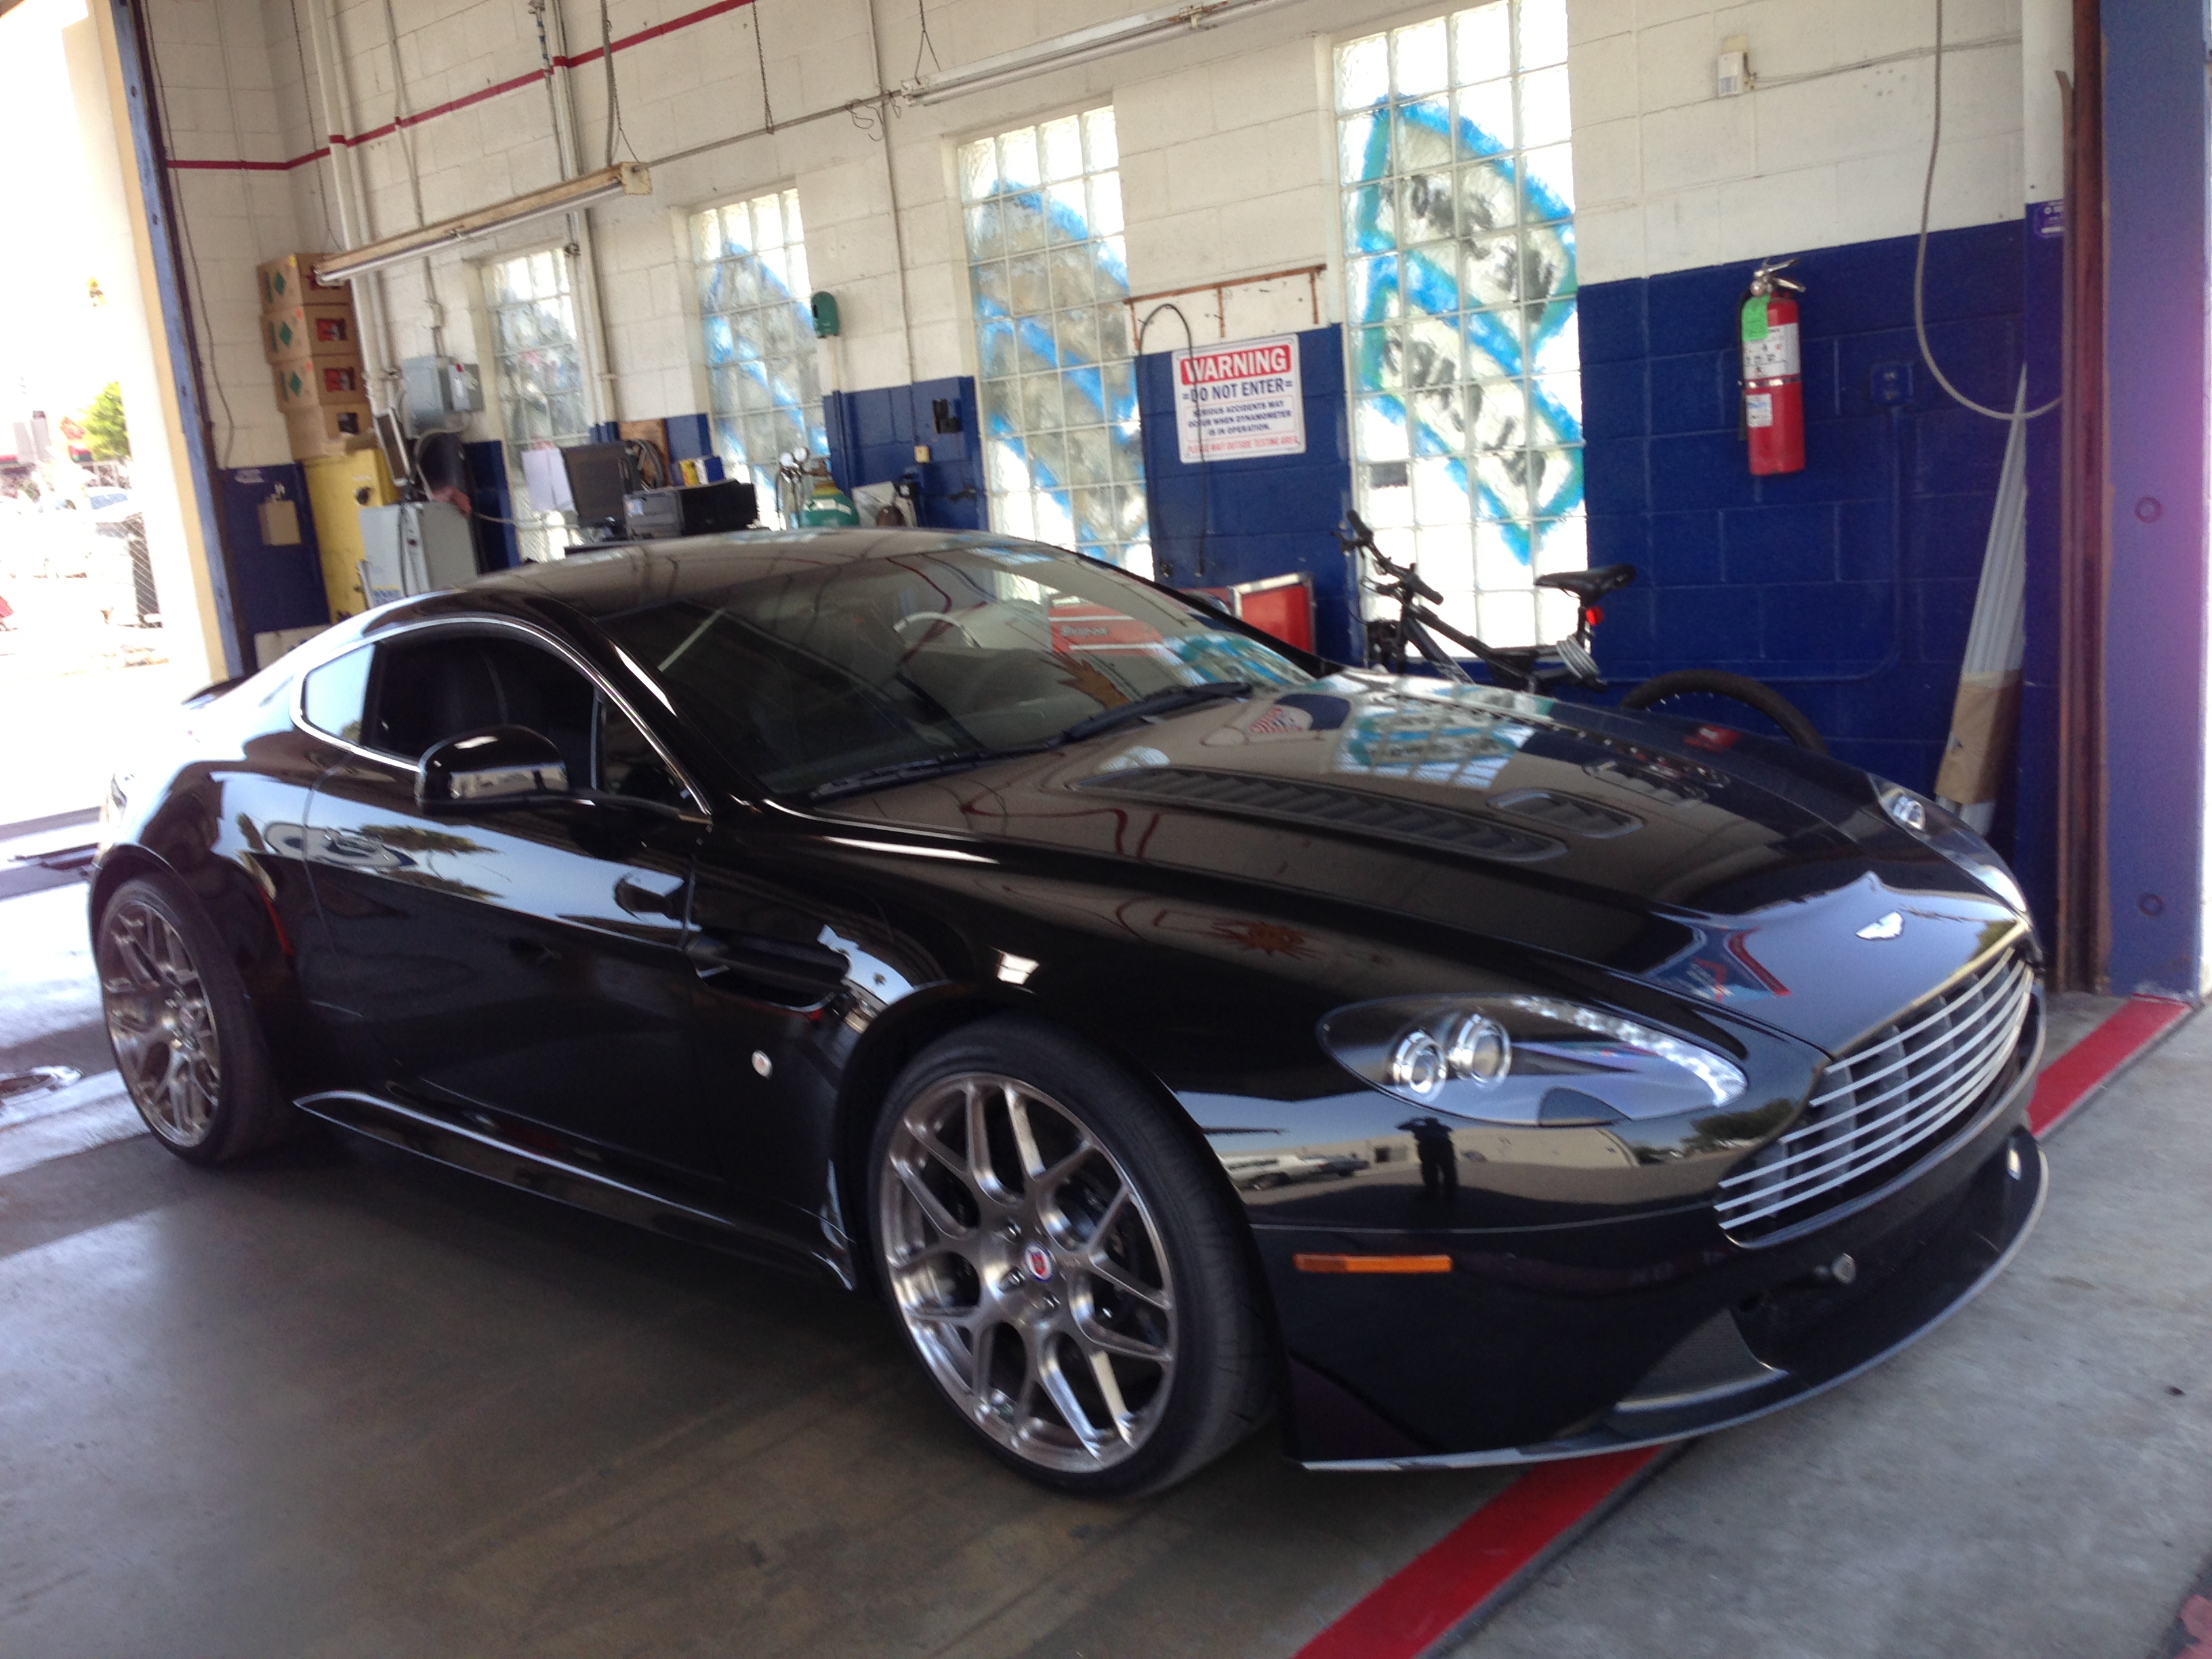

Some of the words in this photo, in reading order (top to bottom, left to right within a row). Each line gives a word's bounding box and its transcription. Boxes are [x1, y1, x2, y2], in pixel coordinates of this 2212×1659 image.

[1184, 348, 1287, 382] WARNING
[1212, 384, 1237, 400] NOT
[1242, 378, 1286, 396] ENTER
